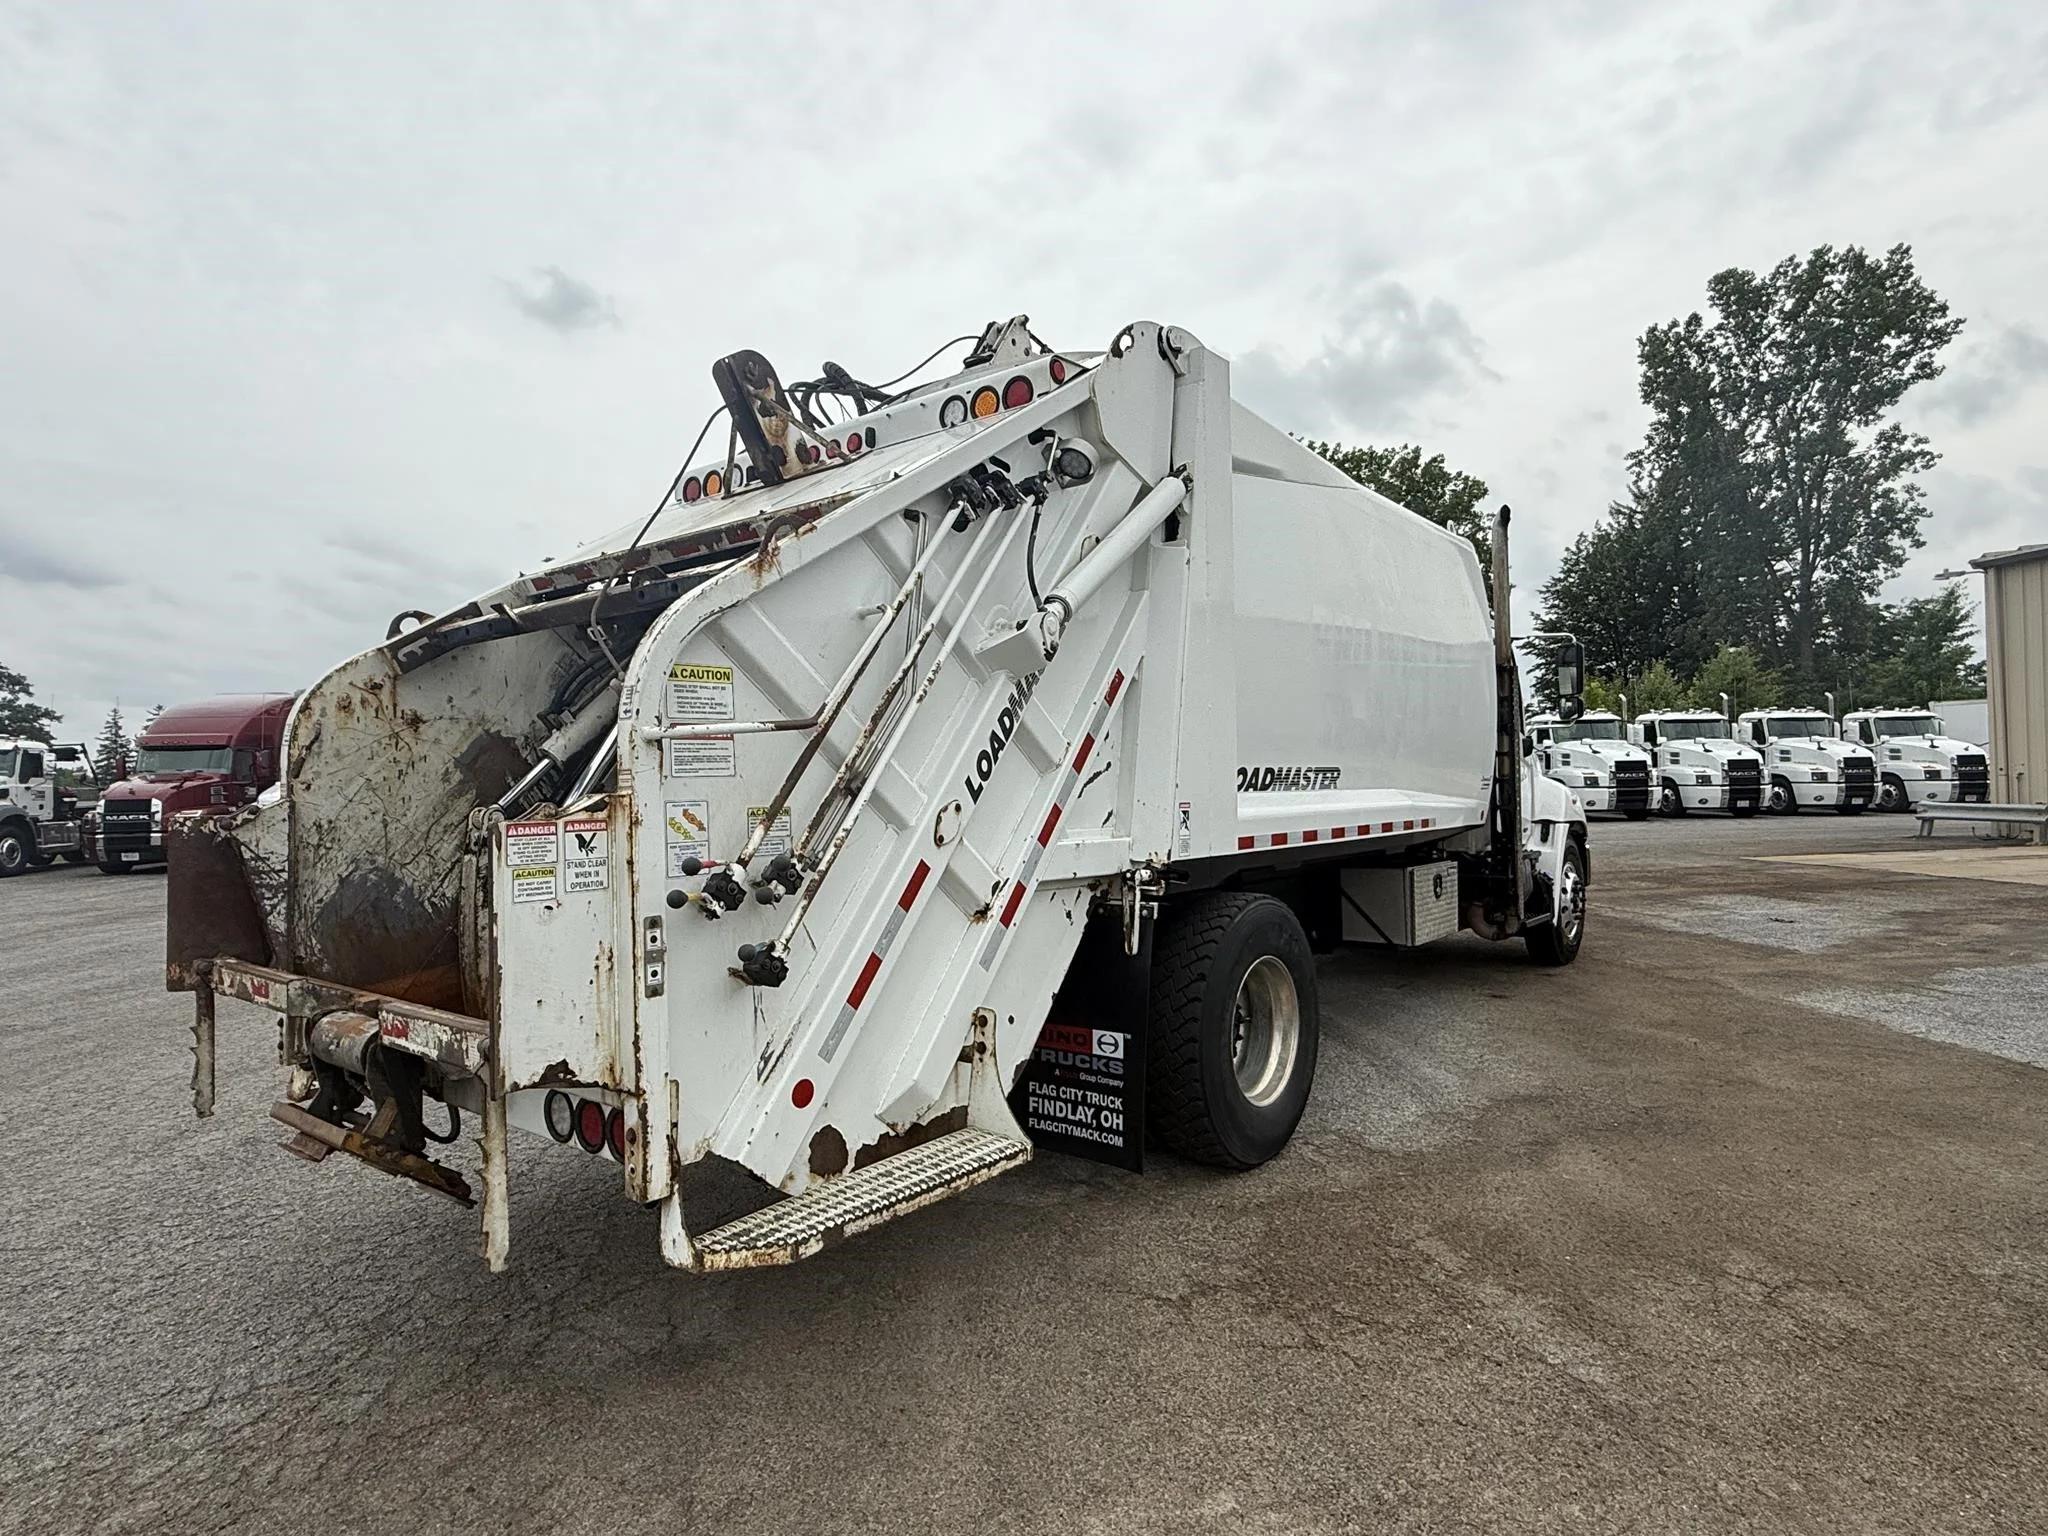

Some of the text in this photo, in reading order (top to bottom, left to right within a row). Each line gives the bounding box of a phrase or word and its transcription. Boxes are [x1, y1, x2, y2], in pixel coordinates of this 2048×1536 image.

[680, 668, 731, 682] CAUTION
[965, 667, 1046, 805] LOADMA
[756, 808, 789, 816] CAON
[517, 825, 556, 835] DANGER
[574, 822, 607, 830] DANGER
[567, 859, 607, 869] STAND CLEAR
[521, 869, 554, 877] CAUTION
[574, 870, 600, 879] WHEN IN
[570, 880, 604, 890] OPERATION
[1055, 1068, 1060, 1076] A
[1080, 1072, 1096, 1083] Group
[1097, 1075, 1124, 1089] Company
[1029, 1081, 1123, 1111] FLAG CITY TRUCK
[1029, 1096, 1124, 1131] FINDLAY, OH
[1029, 1117, 1123, 1147] FLAGCITYMACK.COM
